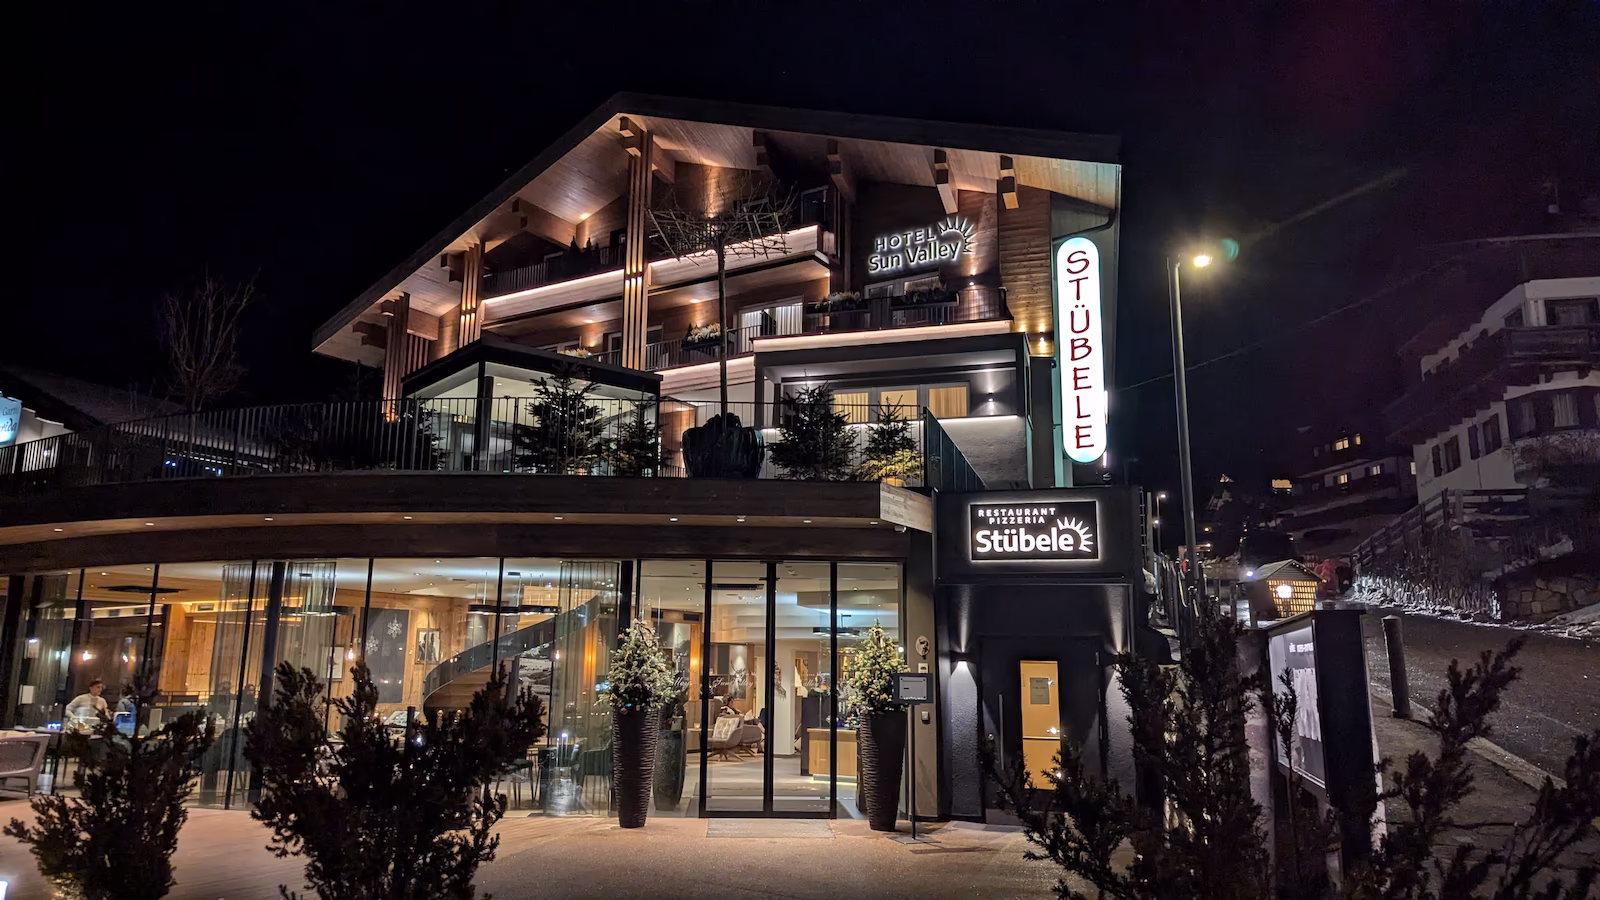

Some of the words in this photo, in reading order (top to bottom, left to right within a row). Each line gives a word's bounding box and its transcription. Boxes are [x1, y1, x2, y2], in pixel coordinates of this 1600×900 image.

[875, 227, 937, 252] HOTEL
[868, 254, 902, 273] Sun
[905, 241, 961, 264] Valley
[1066, 251, 1094, 449] STÜBELE
[0, 417, 17, 431] rida
[978, 507, 1056, 517] RESTAURANT
[989, 516, 1045, 525] PIZZERIA
[976, 527, 1074, 552] Stübele
